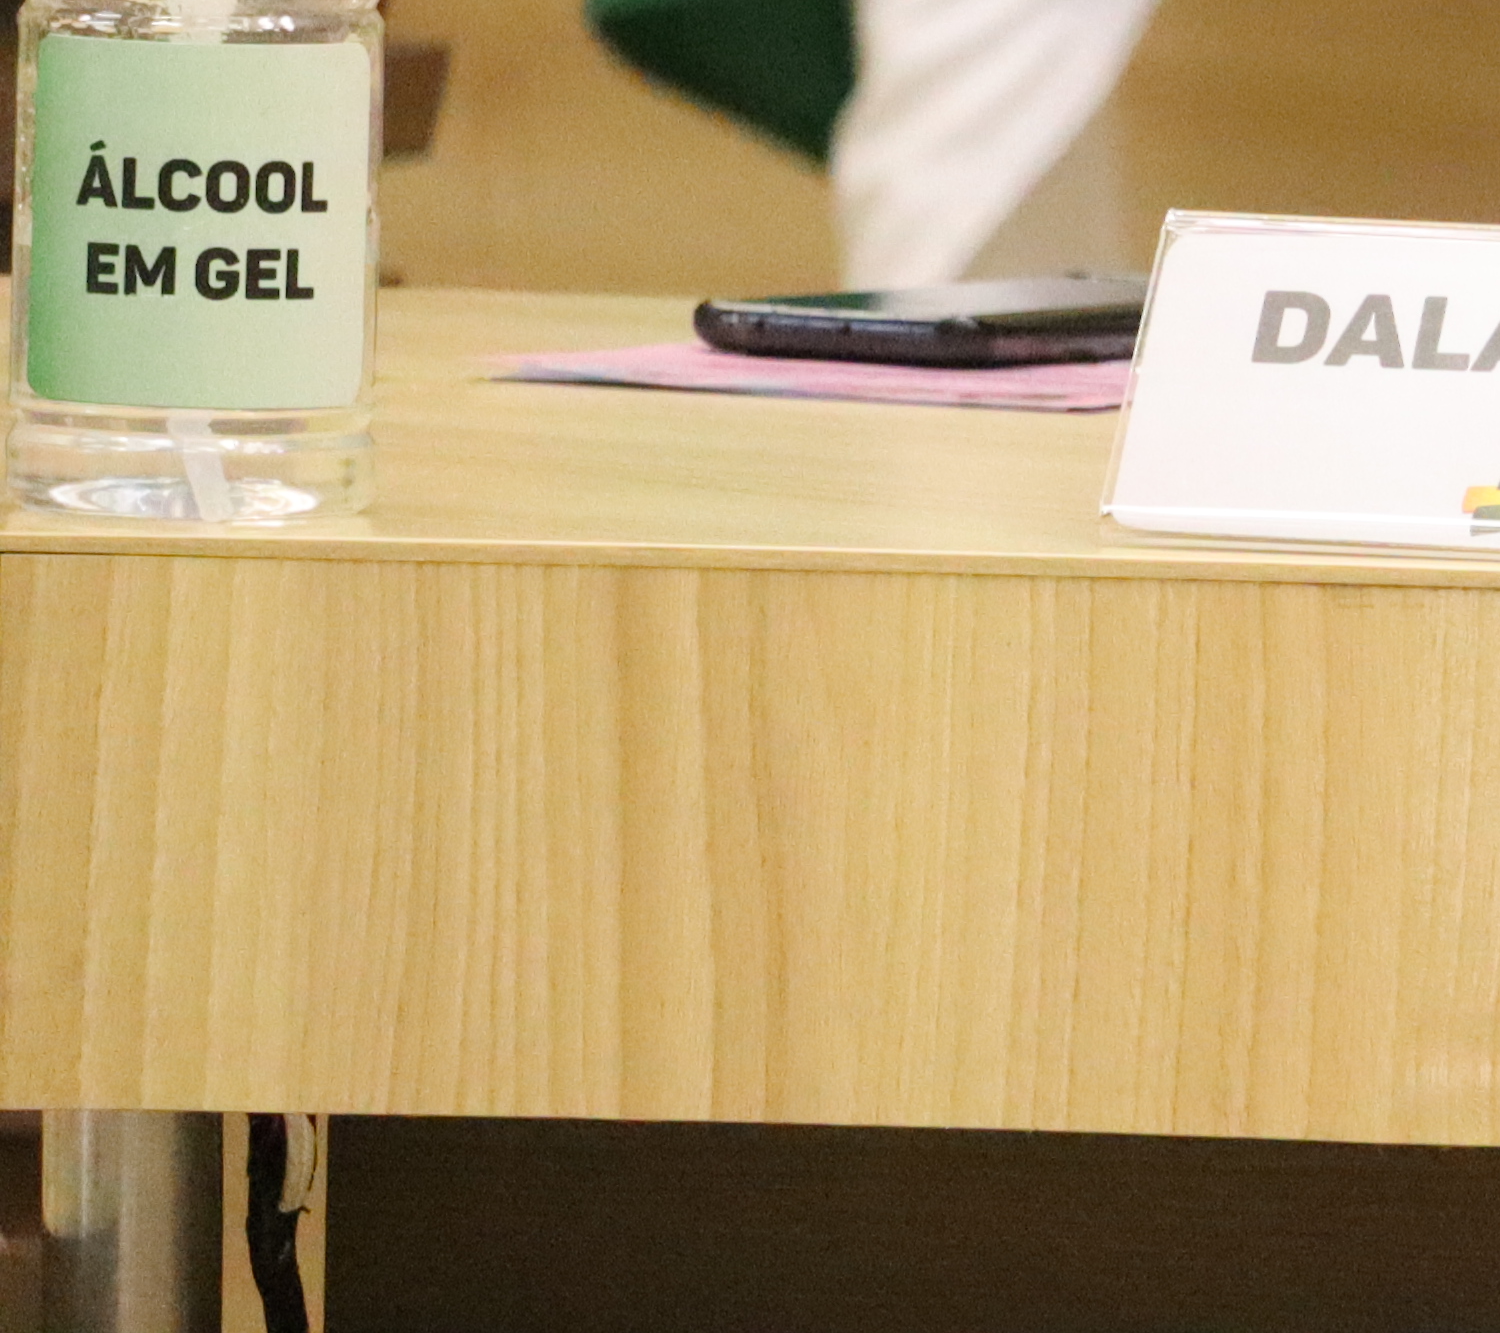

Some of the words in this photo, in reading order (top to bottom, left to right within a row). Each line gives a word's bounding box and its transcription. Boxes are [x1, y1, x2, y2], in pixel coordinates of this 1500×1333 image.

[76, 140, 328, 213] ÁLCOOL
[87, 242, 176, 296] EM
[195, 247, 314, 301] GEL
